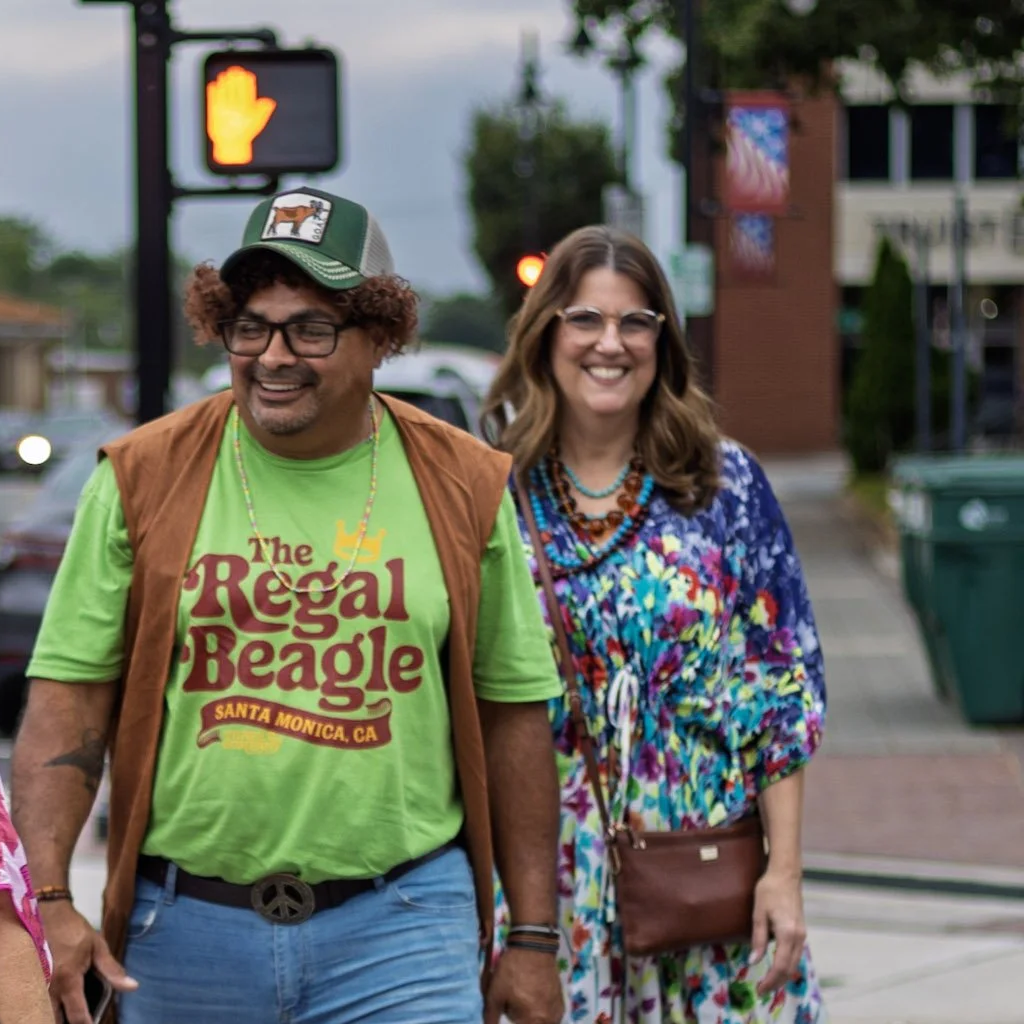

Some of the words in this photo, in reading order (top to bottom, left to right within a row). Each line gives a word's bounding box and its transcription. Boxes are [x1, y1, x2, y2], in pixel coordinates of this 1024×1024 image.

[248, 536, 313, 566] The
[183, 553, 410, 640] Regal
[180, 625, 424, 712] Beagle
[215, 702, 272, 723] SANTA
[275, 711, 350, 744] MONICA,
[352, 725, 378, 744] CA
